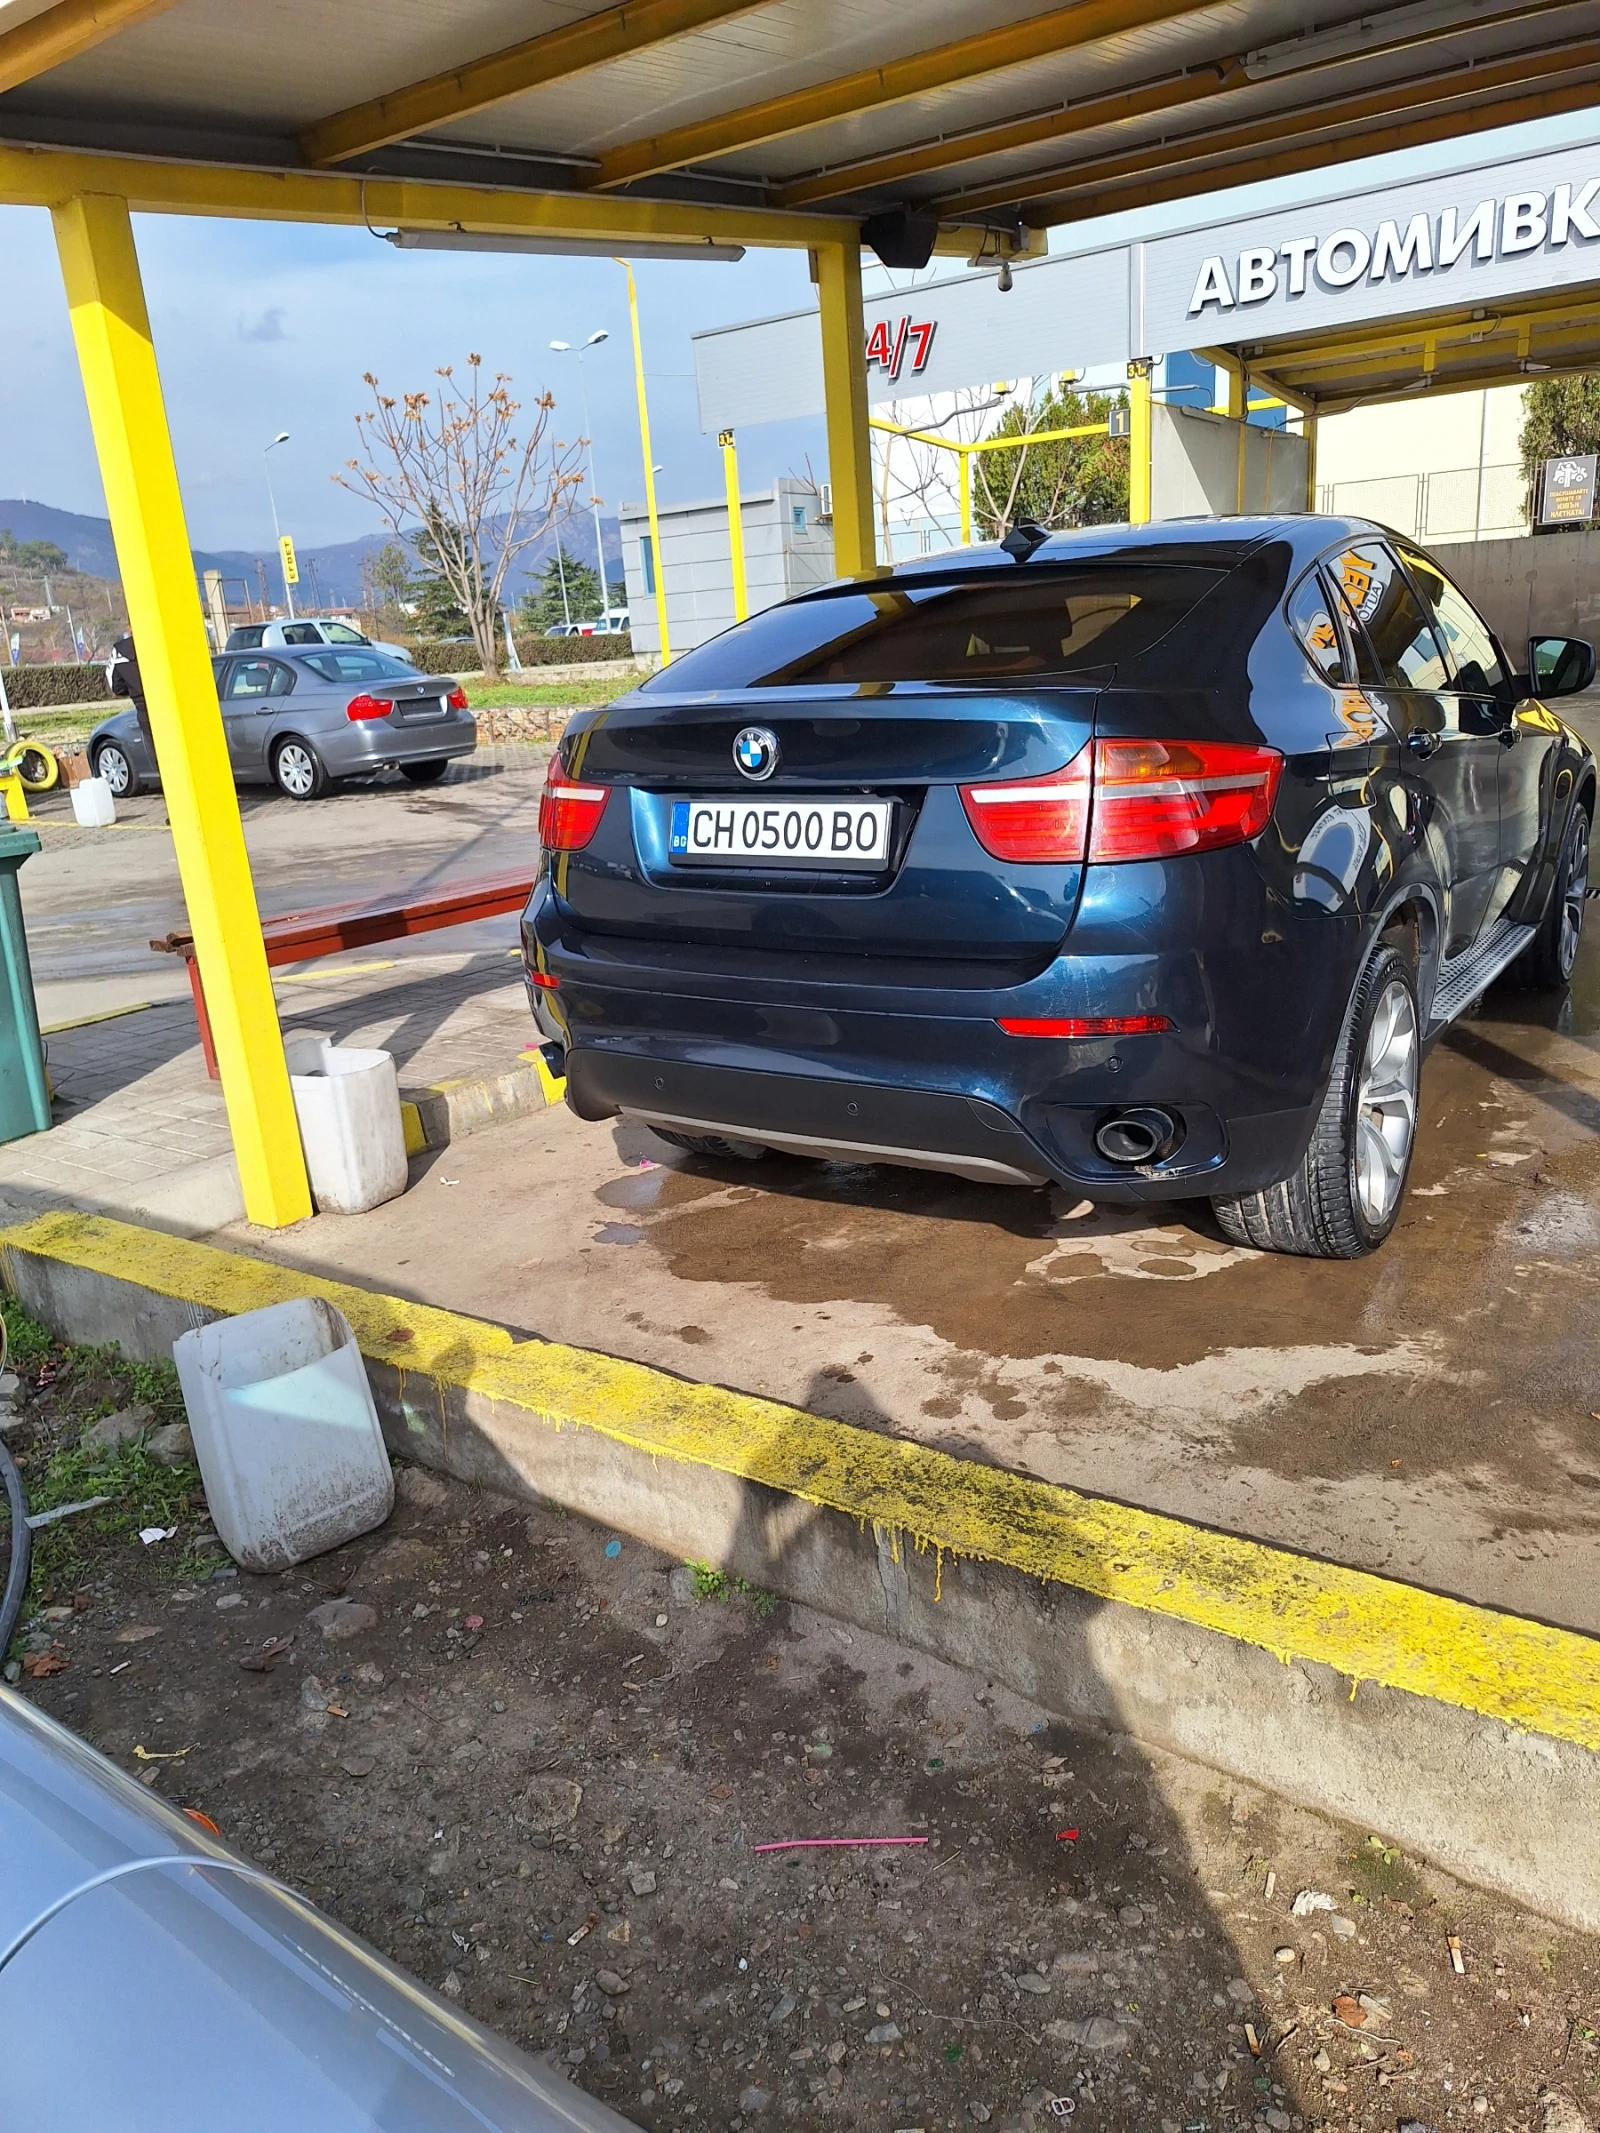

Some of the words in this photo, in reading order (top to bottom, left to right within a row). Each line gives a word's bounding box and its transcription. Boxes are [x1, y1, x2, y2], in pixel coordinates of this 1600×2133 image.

[1187, 178, 1600, 314] АВТОМИВК
[1116, 411, 1124, 433] 1
[673, 835, 687, 848] BG
[693, 810, 735, 849] CH
[742, 810, 823, 850] 0500
[831, 811, 878, 851] BO
